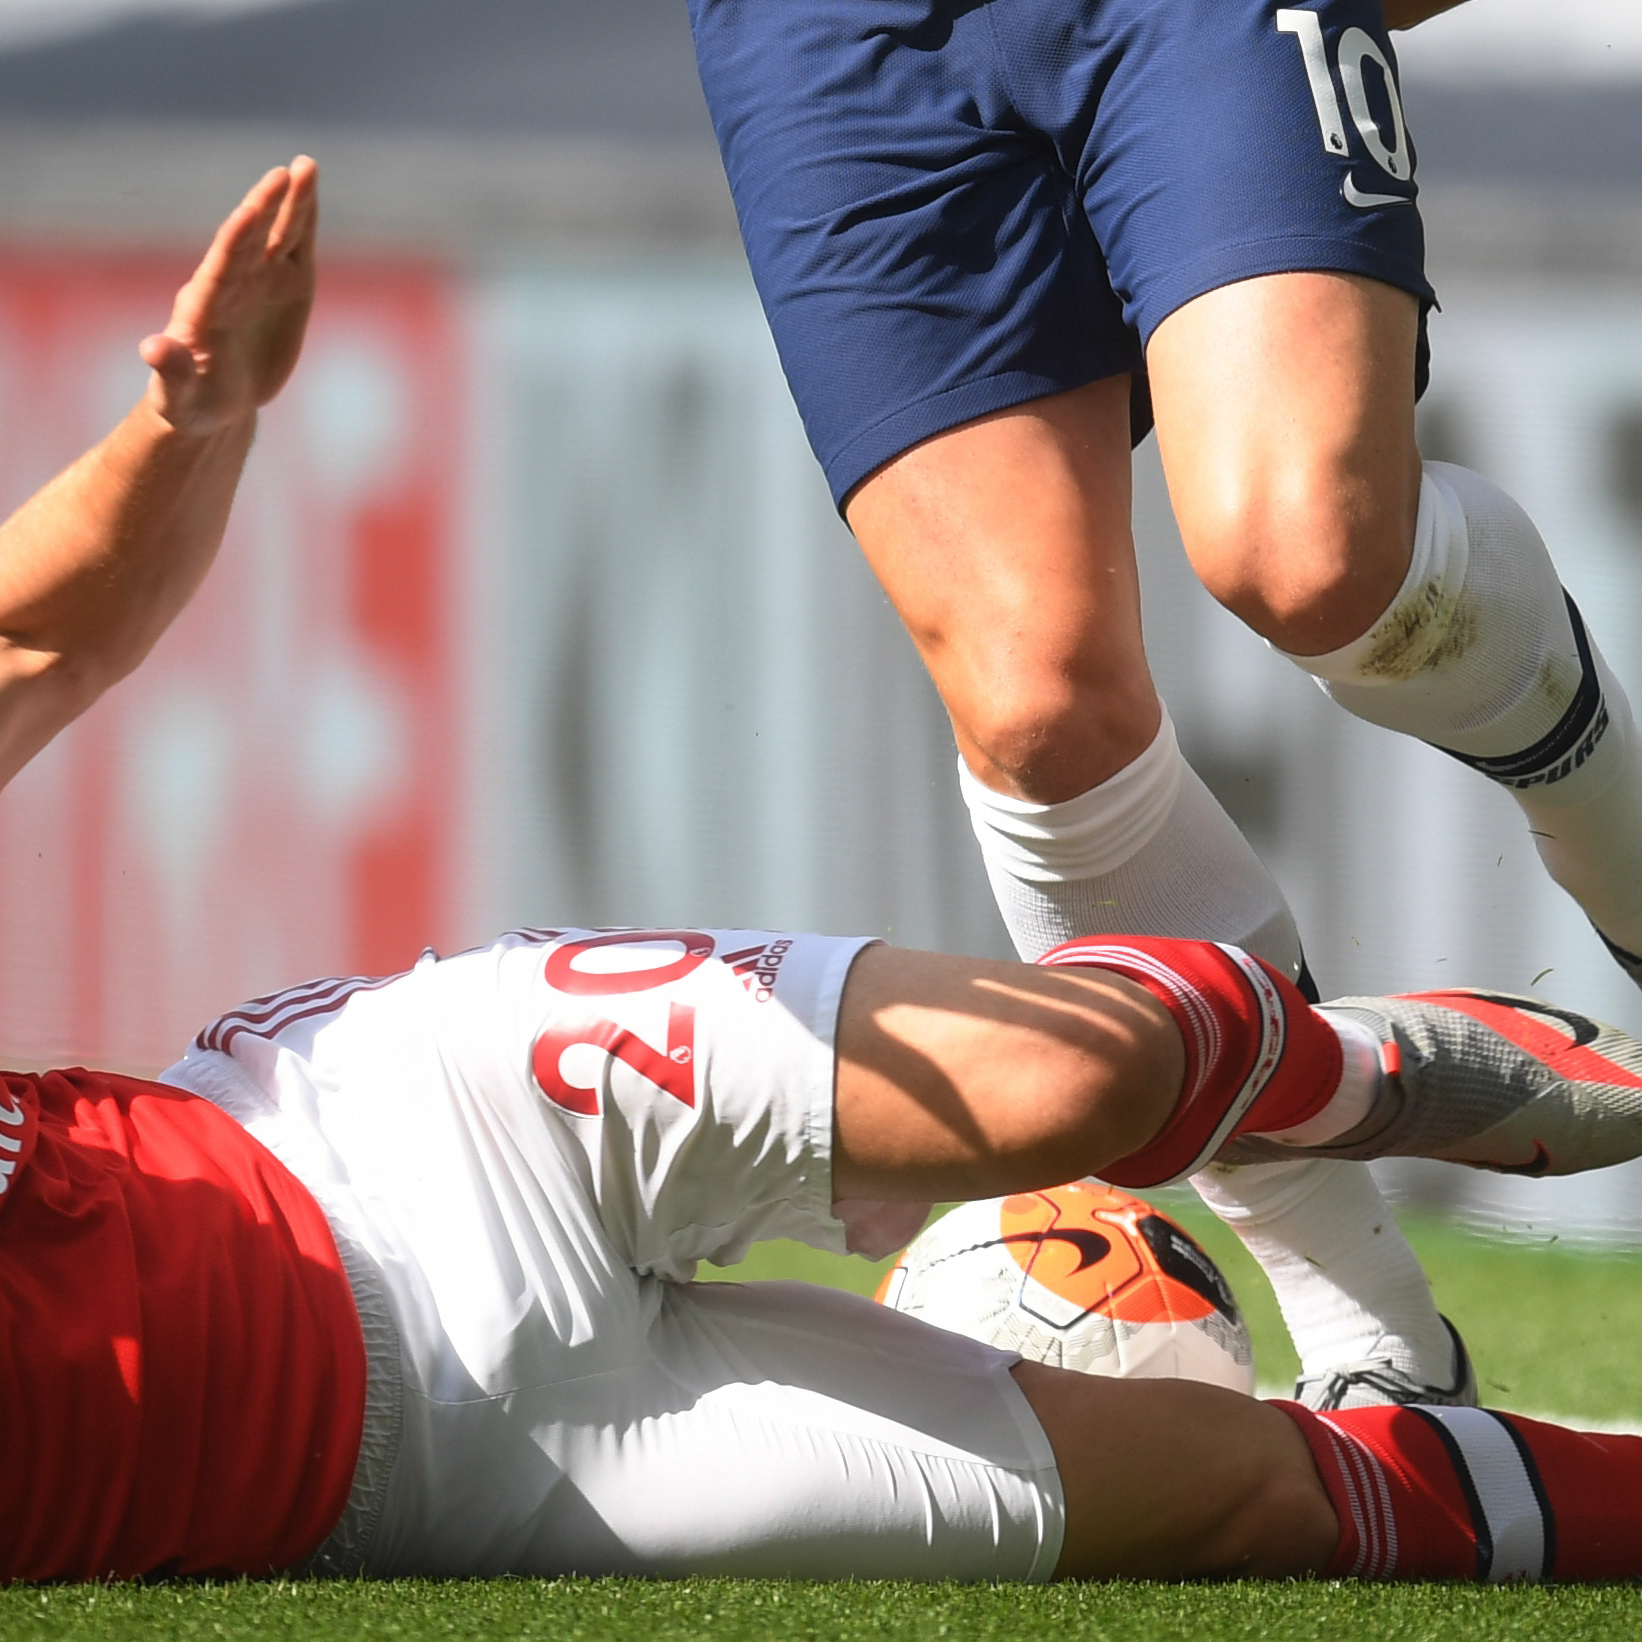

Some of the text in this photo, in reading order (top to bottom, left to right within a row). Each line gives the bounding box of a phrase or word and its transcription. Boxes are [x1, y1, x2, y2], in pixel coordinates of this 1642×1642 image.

[1276, 9, 1411, 181] 10
[532, 928, 715, 1115] 20
[755, 938, 794, 1003] adidas
